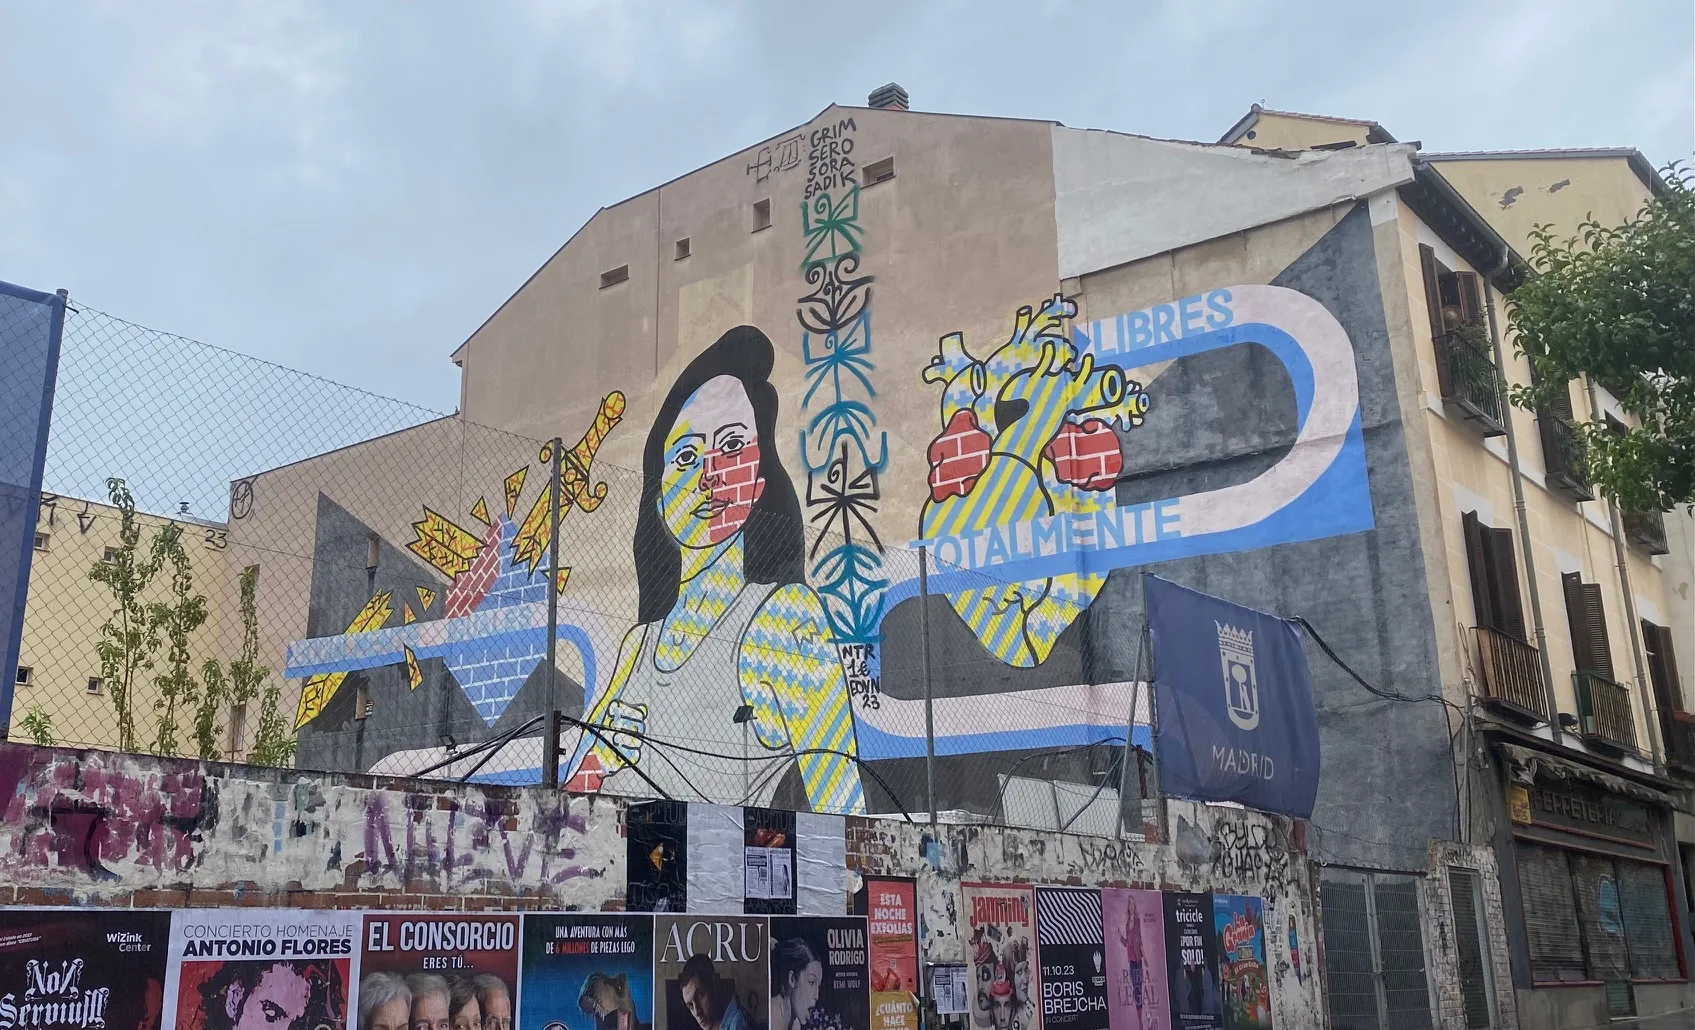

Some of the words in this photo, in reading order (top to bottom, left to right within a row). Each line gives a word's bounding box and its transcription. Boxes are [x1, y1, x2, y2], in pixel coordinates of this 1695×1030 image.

[810, 117, 857, 149] GRIM
[808, 137, 855, 168] SERO
[807, 156, 855, 183] SORA
[804, 169, 858, 200] SADIK
[1091, 288, 1234, 357] LIBRES
[842, 643, 876, 661] NTR
[862, 693, 881, 710] 23
[1212, 745, 1275, 780] MADRID
[880, 893, 902, 906] ESTA
[874, 908, 907, 920] NOCHE
[1175, 909, 1203, 923] tricicle
[106, 931, 143, 943] WiZink
[183, 924, 272, 939] CONCIERTO
[277, 924, 353, 938] HOMENAJE
[369, 922, 394, 951] EL
[399, 921, 515, 951] CONSORCIO
[555, 926, 569, 938] UNA
[570, 926, 600, 938] AVENTURA
[601, 926, 613, 938] CON
[614, 922, 628, 938] MÁS
[870, 923, 913, 935] EXFOLIAS
[659, 921, 764, 964] ACRU
[827, 928, 864, 949] OLIVIA
[1194, 935, 1203, 947] FIN
[118, 943, 152, 952] Center
[182, 939, 276, 957] ANTONIO
[281, 938, 352, 955] FLORES
[545, 942, 554, 954] DE
[590, 941, 598, 953] DE
[600, 941, 620, 953] PIEZAS
[621, 941, 636, 953] LEGO
[423, 957, 447, 969] ERES
[450, 954, 475, 969] TÚ...
[828, 950, 865, 966] RODRIGO
[1042, 965, 1075, 976] 11.10.23
[1043, 981, 1084, 998] BORIS
[1044, 996, 1107, 1014] BREJCHA
[883, 1015, 906, 1027] HACE
